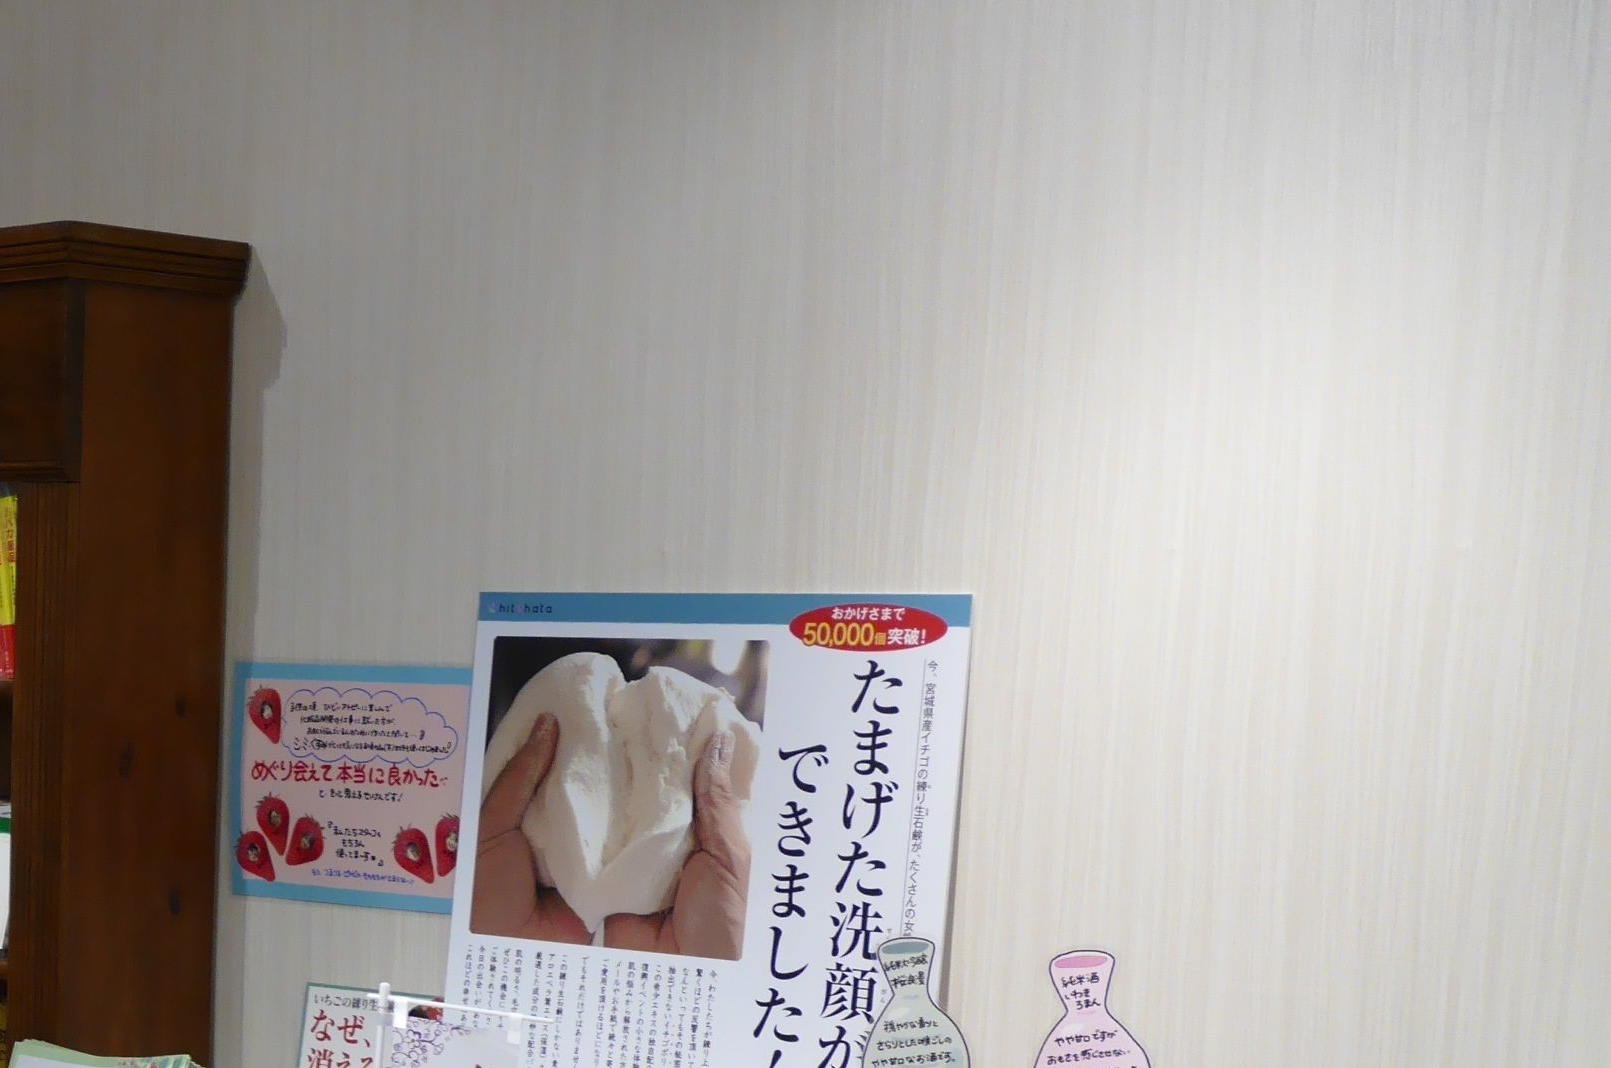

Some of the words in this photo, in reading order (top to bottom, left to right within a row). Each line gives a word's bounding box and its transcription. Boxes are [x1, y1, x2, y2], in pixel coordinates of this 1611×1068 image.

[831, 606, 906, 621] おかげさまで
[802, 621, 927, 647] 50,000個突破!
[1061, 972, 1100, 989] 純米酒
[1064, 987, 1092, 1001] いわき
[1075, 998, 1102, 1011] ろまん
[310, 1009, 372, 1048] なぜ、
[1054, 1029, 1118, 1047] やや甘口ですが
